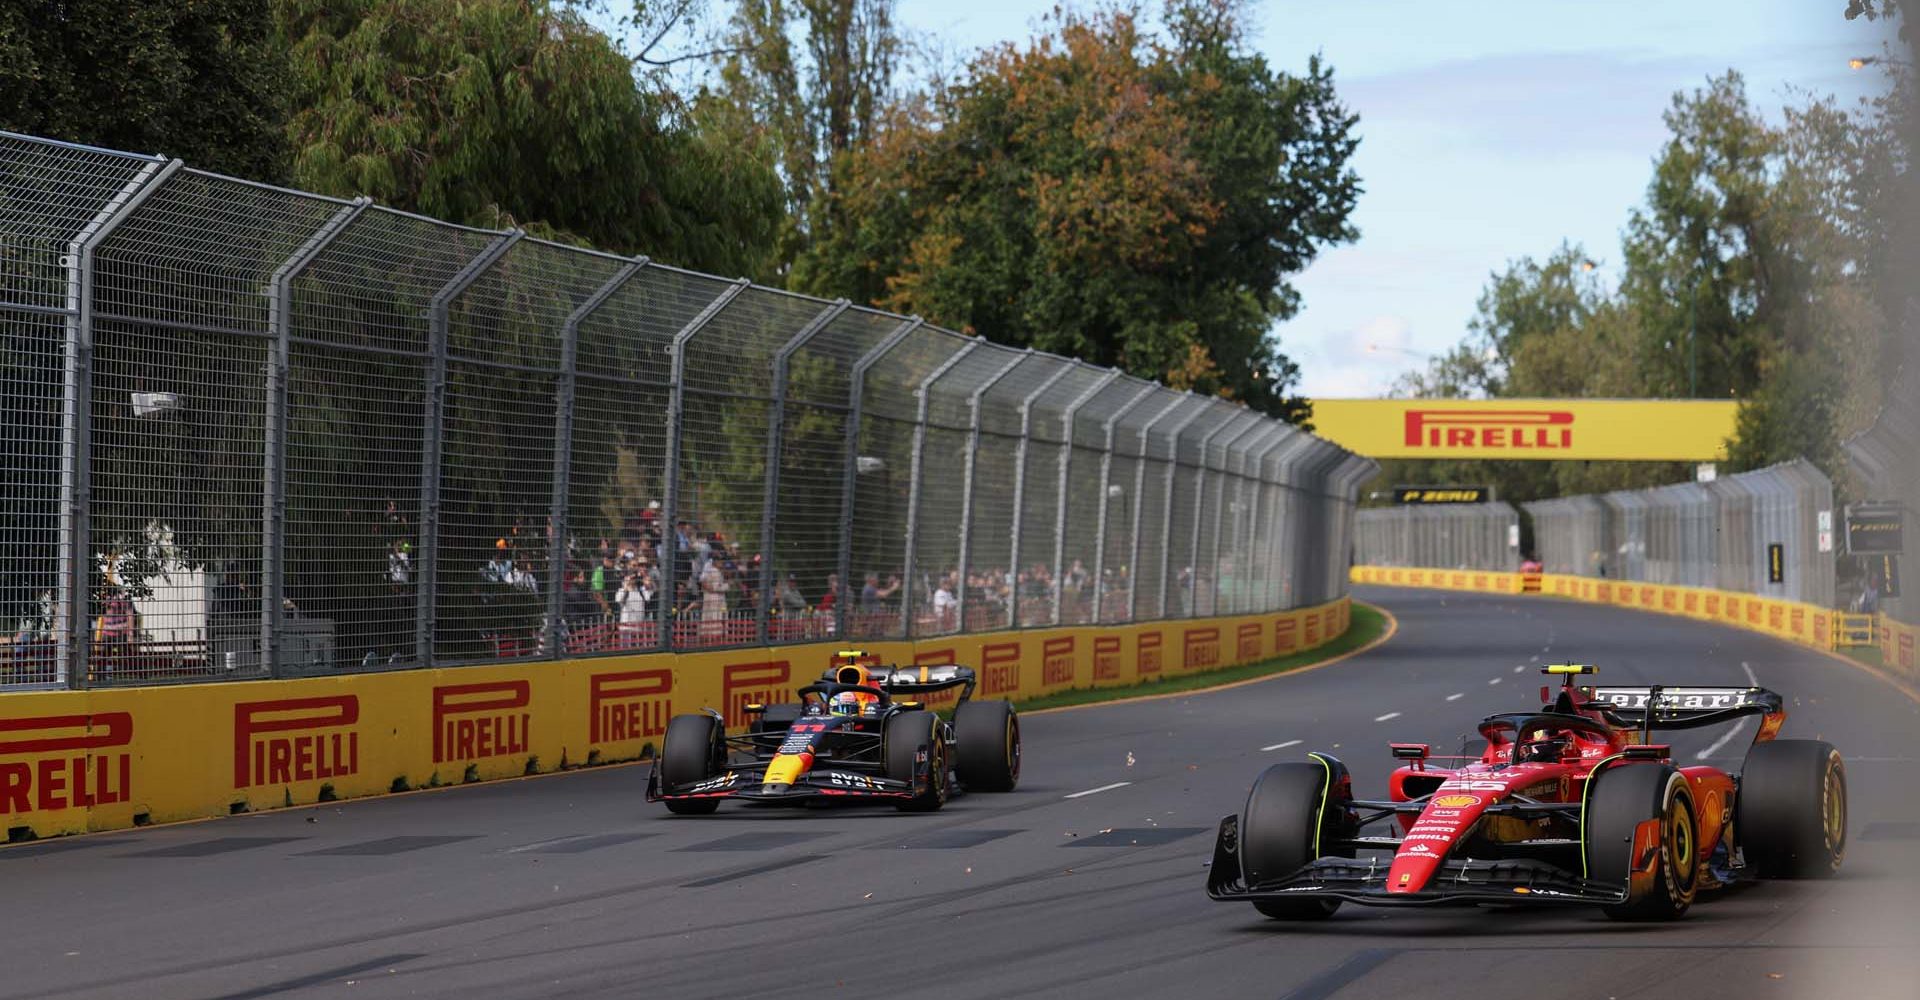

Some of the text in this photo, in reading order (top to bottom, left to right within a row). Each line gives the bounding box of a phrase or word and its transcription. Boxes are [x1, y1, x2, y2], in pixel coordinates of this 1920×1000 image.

[1405, 411, 1574, 447] PIRELLI
[234, 694, 359, 788] PIRELLI
[433, 680, 530, 764] PIRELLI
[590, 669, 672, 744] PIRELLI
[1437, 780, 1509, 791] 55
